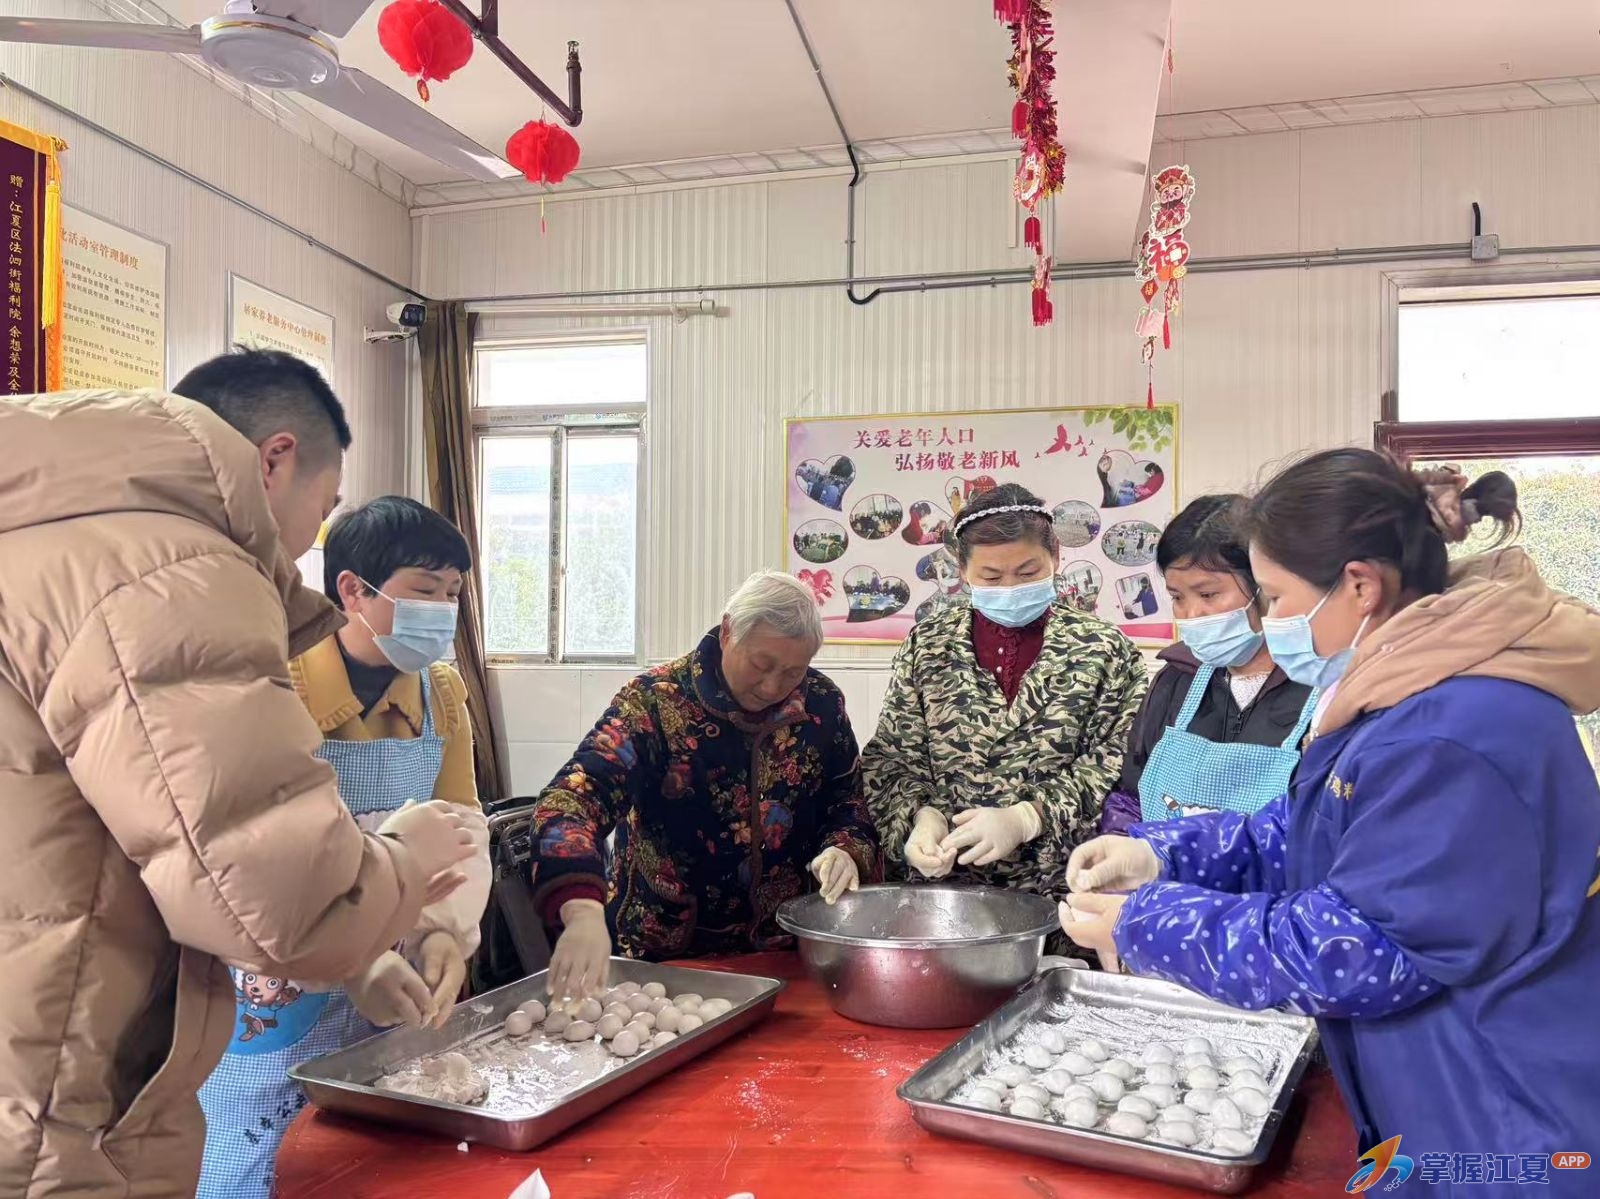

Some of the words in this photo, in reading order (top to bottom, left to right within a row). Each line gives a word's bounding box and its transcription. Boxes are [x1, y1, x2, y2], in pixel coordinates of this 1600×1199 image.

[7, 325, 23, 396] 余想荣及全
[853, 427, 975, 449] 关爱老年人口
[895, 449, 1020, 472] 弘扬敬老新风
